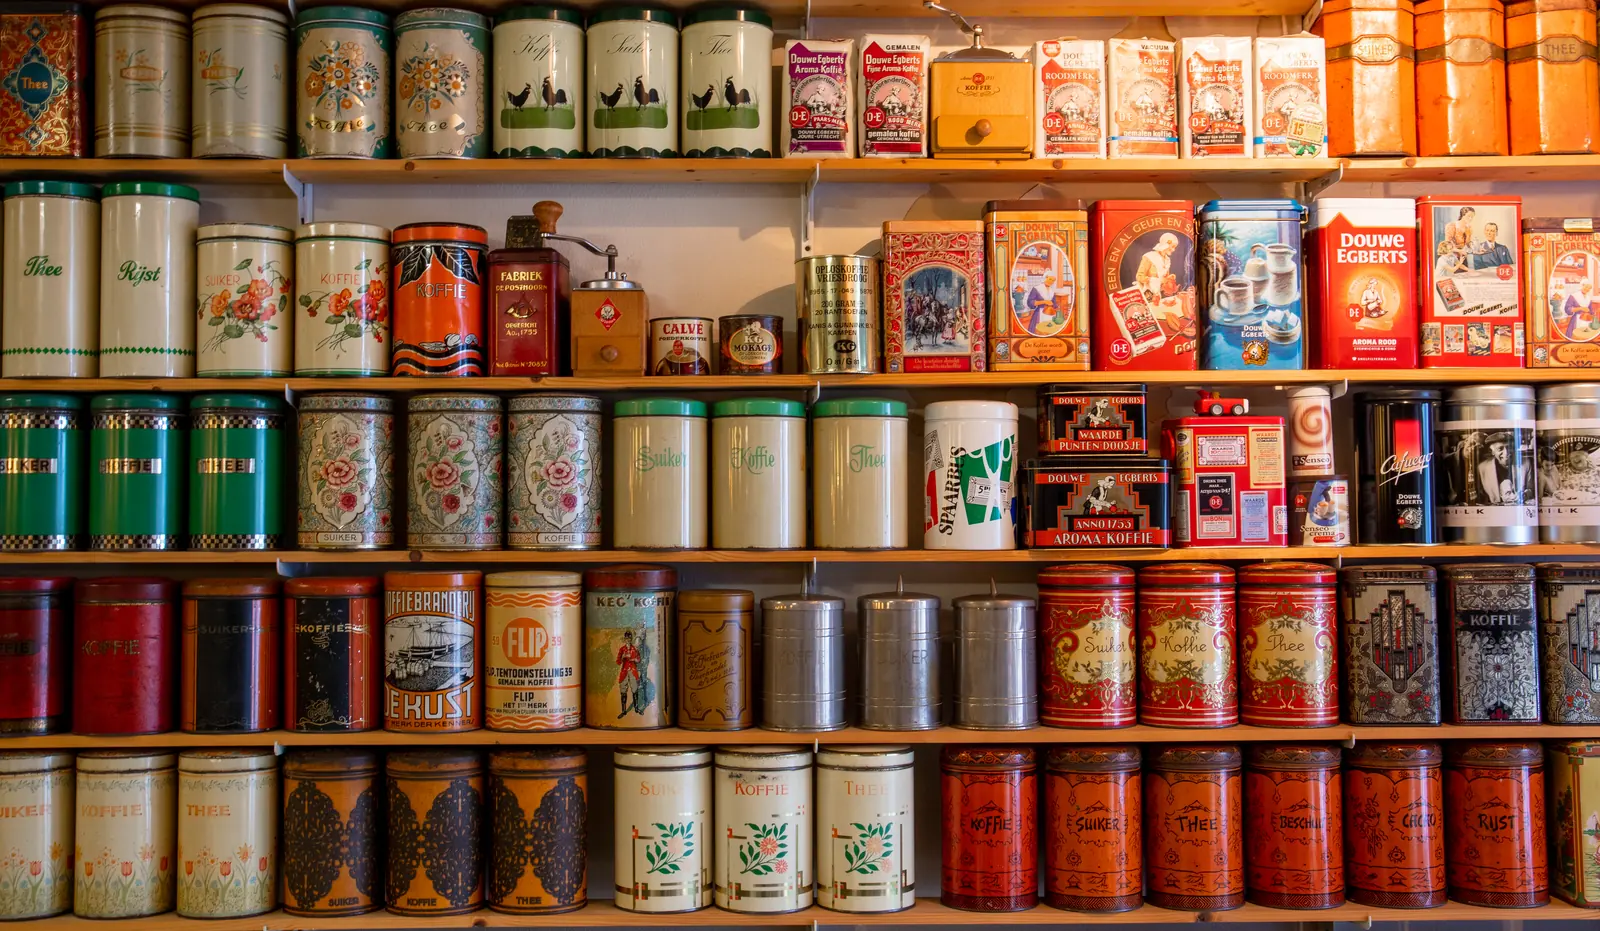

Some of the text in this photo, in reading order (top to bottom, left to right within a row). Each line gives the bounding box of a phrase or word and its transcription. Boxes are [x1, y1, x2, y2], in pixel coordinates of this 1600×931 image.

[1358, 45, 1394, 55] SUIKER
[1544, 44, 1576, 55] THEE
[791, 54, 844, 64] Douwe Egberts
[866, 54, 920, 65] Douwe Egberts
[1143, 57, 1169, 66] Egberts
[1214, 64, 1240, 73] Egberts
[1045, 72, 1095, 80] ROODMERK
[1264, 72, 1314, 80] ROODMERK
[21, 77, 48, 90] Thee
[406, 120, 448, 132] Thee
[1293, 122, 1303, 135] 15
[868, 130, 919, 139] gemalen koffie
[1018, 232, 1066, 246] EGBERTS
[1108, 217, 1182, 290] EEN EN AL GEUR EN
[1555, 242, 1600, 256] EGBERTS
[1337, 249, 1407, 263] EGBERTS
[24, 255, 62, 276] Thee
[816, 265, 868, 274] OPLOSKOFFIE
[117, 260, 161, 287] Rijst
[320, 273, 360, 285] KOFFIE
[501, 271, 542, 281] FABRIEK
[817, 274, 867, 282] VRIESDROOG
[205, 274, 240, 286] SUIKER
[416, 284, 467, 299] KOFFIE
[1463, 303, 1484, 315] DOUWE
[1480, 303, 1503, 315] EGBERTS
[663, 322, 703, 334] CALVÉ
[744, 335, 763, 344] KG
[1111, 396, 1141, 404] EGBERTS
[1079, 430, 1121, 439] WAARDE
[635, 445, 687, 472] Suiker
[731, 446, 776, 475] Koffie
[849, 444, 886, 472] Thee
[1299, 456, 1330, 465] Senseo
[1379, 451, 1434, 486] Cafuego
[1048, 474, 1158, 482] DOUWE EGBERTS
[939, 446, 967, 536] SPAARBUS
[978, 485, 984, 494] 5
[1076, 519, 1105, 529] ANNO
[1300, 525, 1329, 533] Senseo
[324, 534, 357, 542] SUIKER
[544, 534, 577, 542] KOFFIE
[1366, 571, 1420, 579] SUIKER
[384, 590, 475, 622] OFFIEBRANDERIJ
[1470, 614, 1521, 626] KOFFIE
[200, 625, 248, 634] SUIKER
[300, 624, 344, 633] KOFFIE
[507, 626, 548, 659] FLIP
[551, 636, 562, 646] 39
[1084, 636, 1126, 654] Suiker
[1160, 634, 1207, 653] Koffie
[1265, 634, 1305, 652] Thee
[403, 681, 475, 720] KUST
[513, 692, 535, 702] FLIP
[735, 780, 789, 796] KOFFIE
[844, 780, 888, 796] THEE
[81, 804, 143, 817] KOFFIE
[187, 804, 231, 817] THEE
[970, 815, 1012, 835] KOFFIE
[1075, 816, 1121, 833] SUIKER
[1175, 815, 1217, 832] THEE
[1478, 813, 1518, 831] RIJST
[328, 897, 359, 907] SUIKER
[407, 898, 437, 907] KOFFIE
[516, 896, 542, 905] THEE
